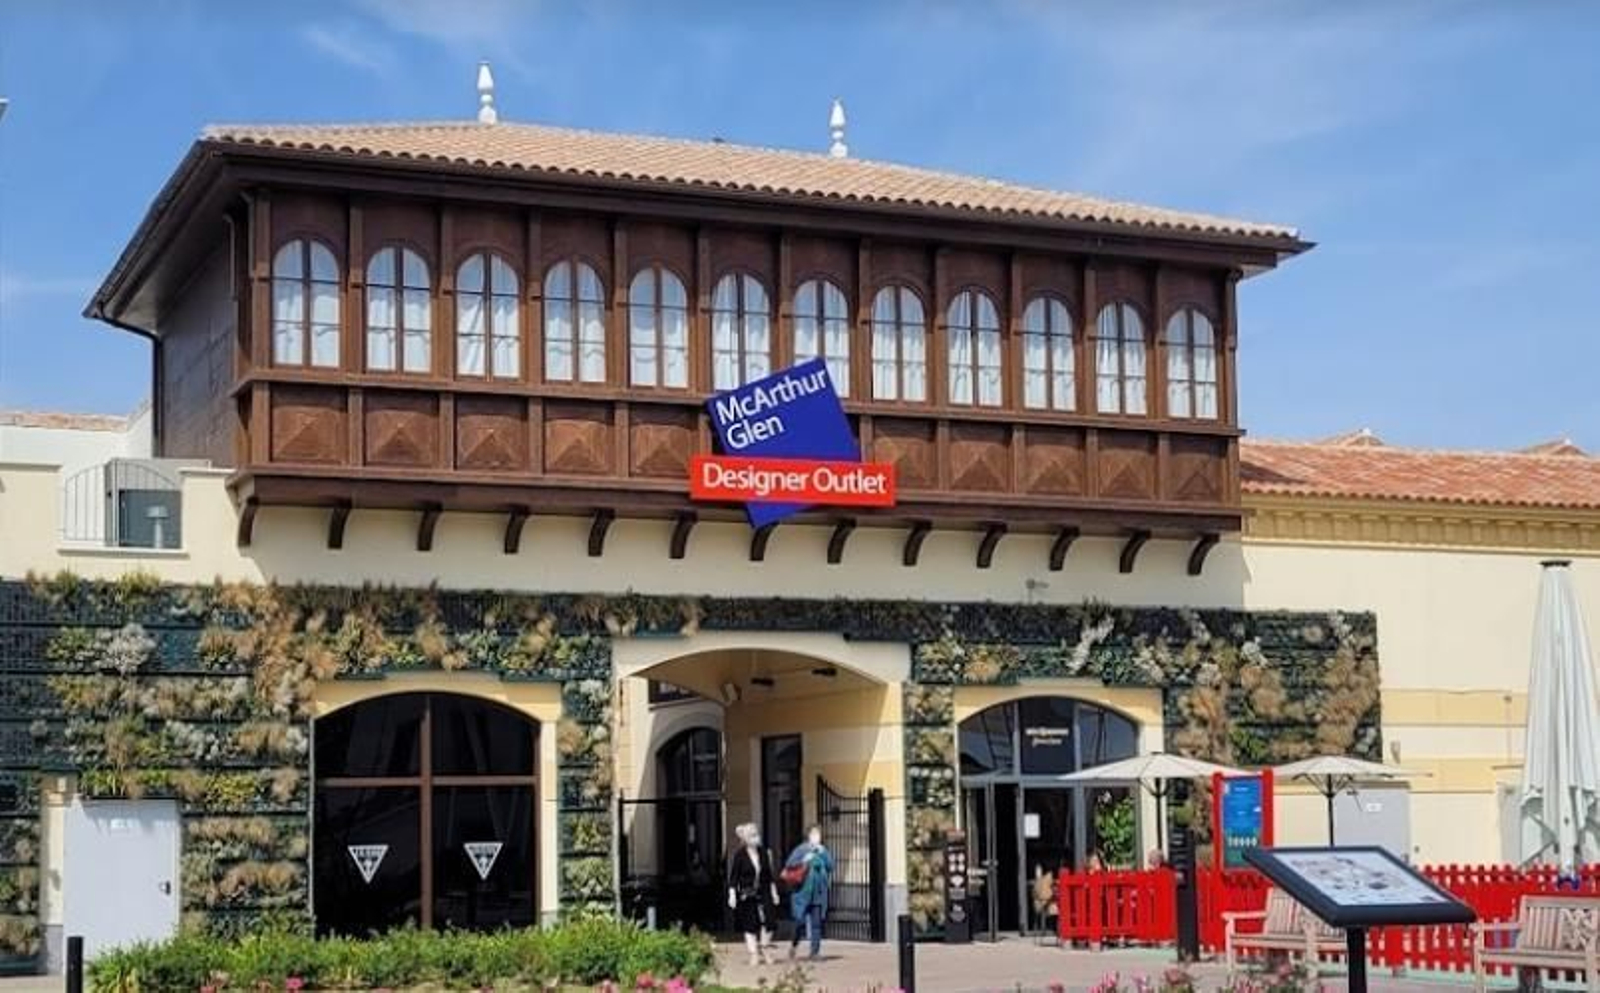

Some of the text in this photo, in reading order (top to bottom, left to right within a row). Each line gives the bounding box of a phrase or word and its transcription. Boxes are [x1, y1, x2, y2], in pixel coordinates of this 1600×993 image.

[716, 369, 826, 425] McArthur
[726, 415, 785, 449] Glen
[703, 462, 886, 496] Designer Outlet
